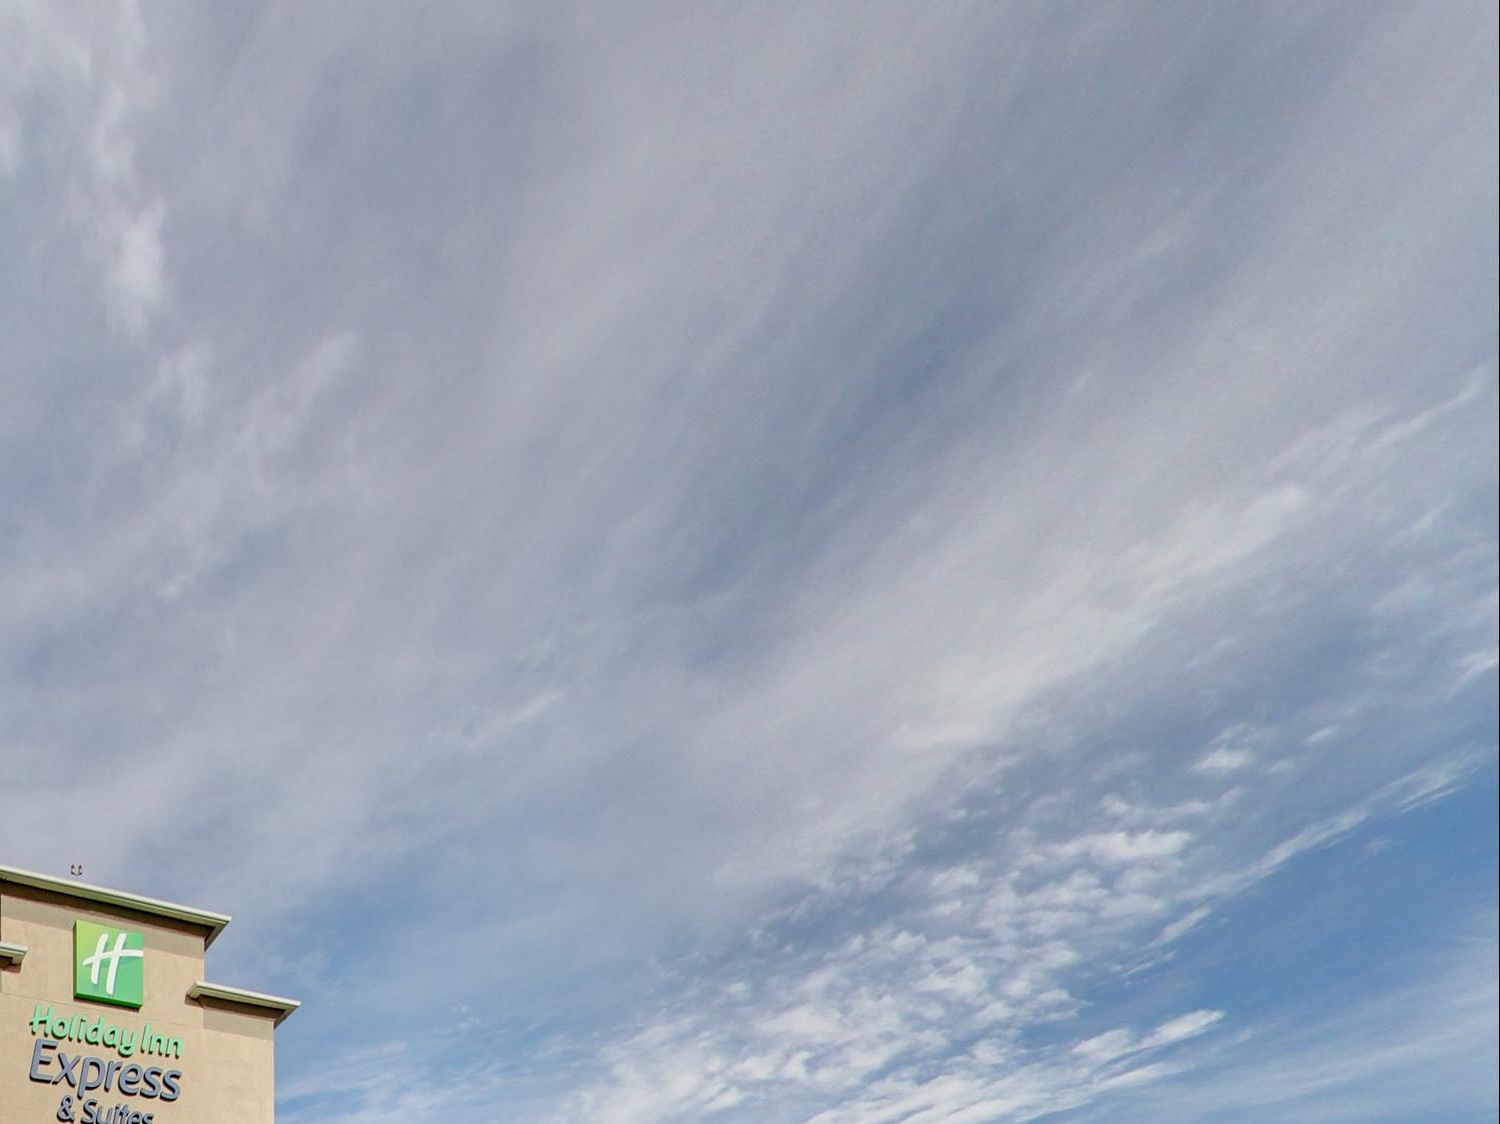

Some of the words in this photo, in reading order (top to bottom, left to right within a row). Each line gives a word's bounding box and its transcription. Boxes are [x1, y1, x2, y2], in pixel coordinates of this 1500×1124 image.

[29, 1004, 138, 1057] Holiday
[140, 1023, 183, 1059] Inn
[29, 1038, 182, 1101] Express
[57, 1094, 76, 1124] &
